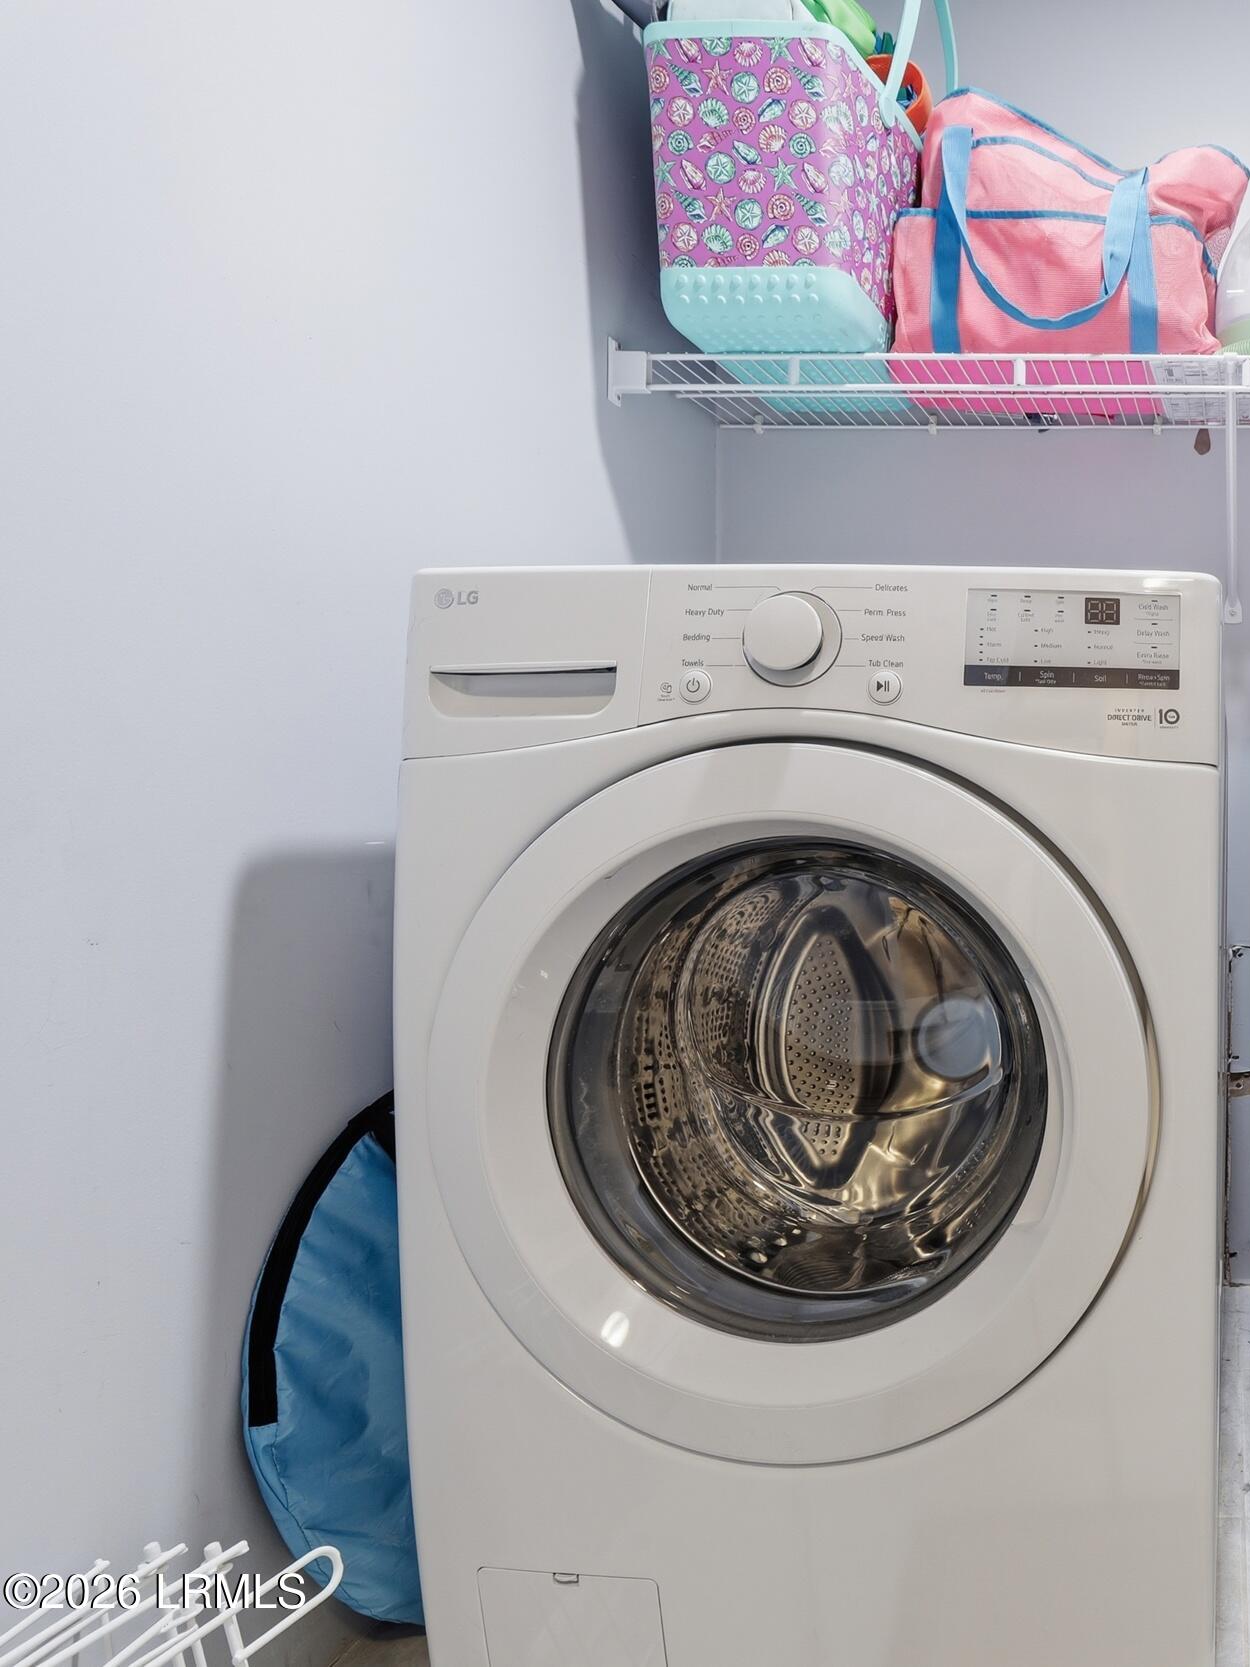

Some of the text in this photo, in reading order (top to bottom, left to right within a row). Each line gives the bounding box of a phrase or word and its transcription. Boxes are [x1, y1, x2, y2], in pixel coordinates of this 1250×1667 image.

[875, 584, 908, 592] Delicates
[685, 608, 725, 617] Heavy Duty
[887, 608, 907, 617] Press
[682, 633, 711, 643] Bedding
[861, 633, 905, 643] Speed Wash
[682, 659, 704, 667] Towels
[868, 659, 904, 668] Tub Clean
[1039, 670, 1055, 679] Spin
[1094, 674, 1107, 682] Soil
